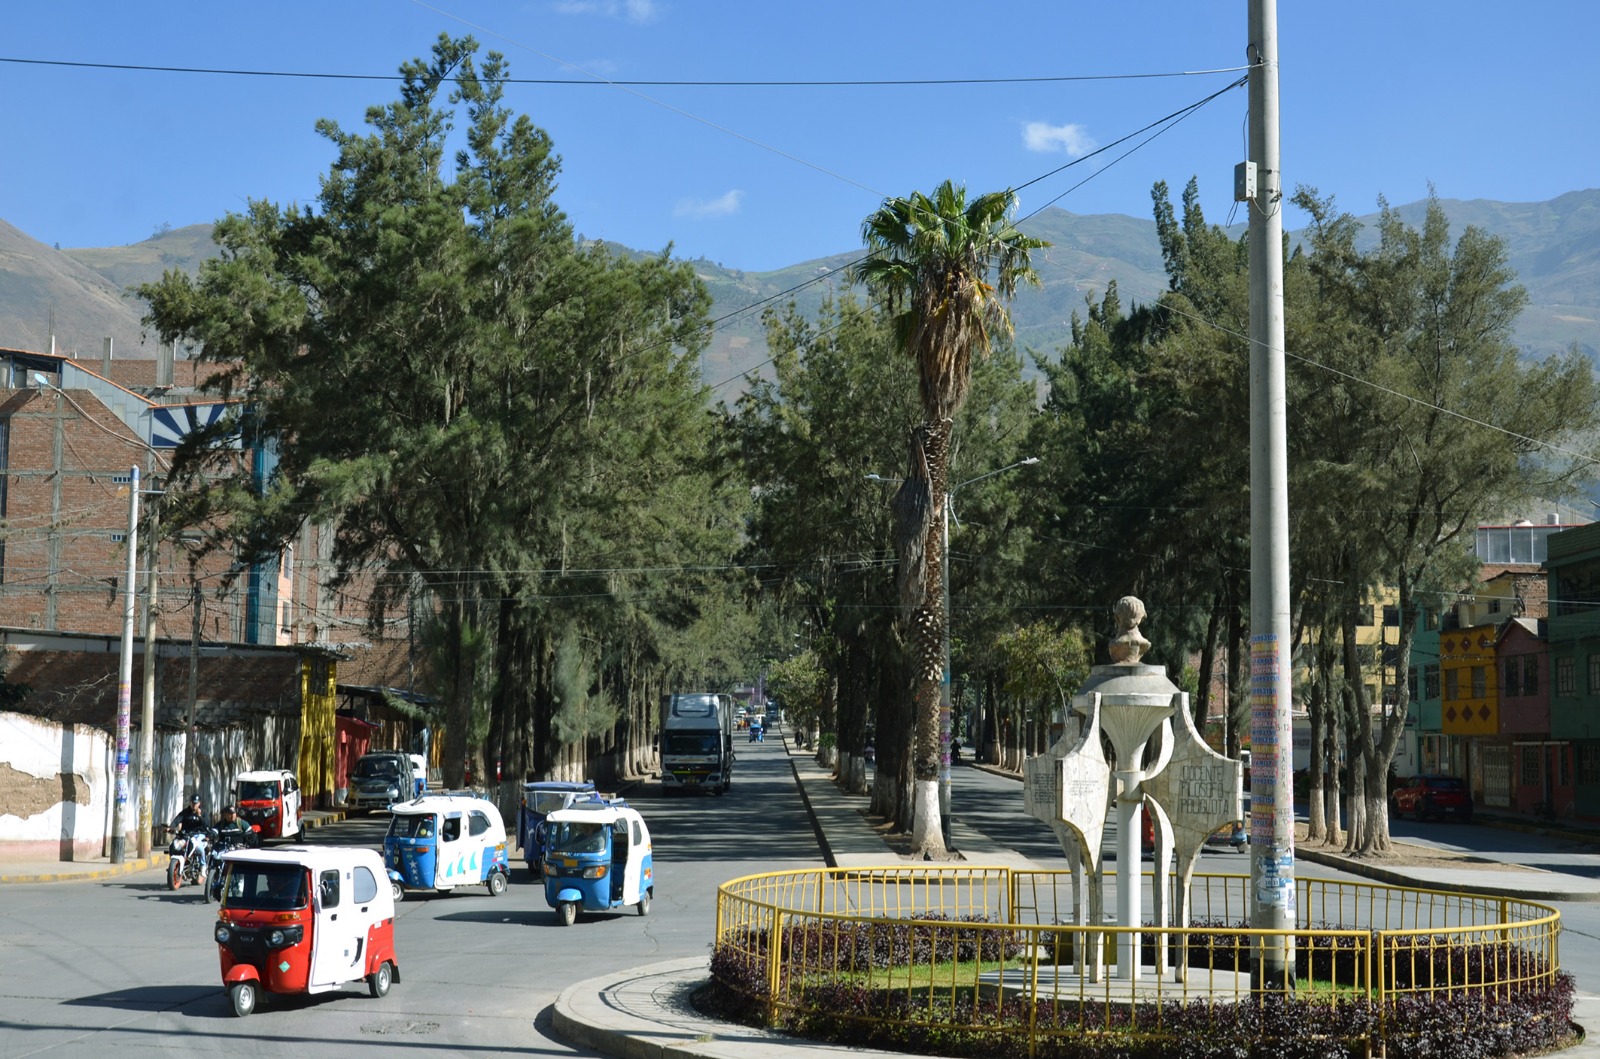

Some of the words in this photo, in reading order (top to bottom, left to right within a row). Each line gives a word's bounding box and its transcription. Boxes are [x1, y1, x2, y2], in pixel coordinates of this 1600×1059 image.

[1182, 765, 1224, 781] DOCENTE
[1181, 781, 1224, 798] FILOSOFO
[1180, 798, 1230, 815] POLIGLOTA
